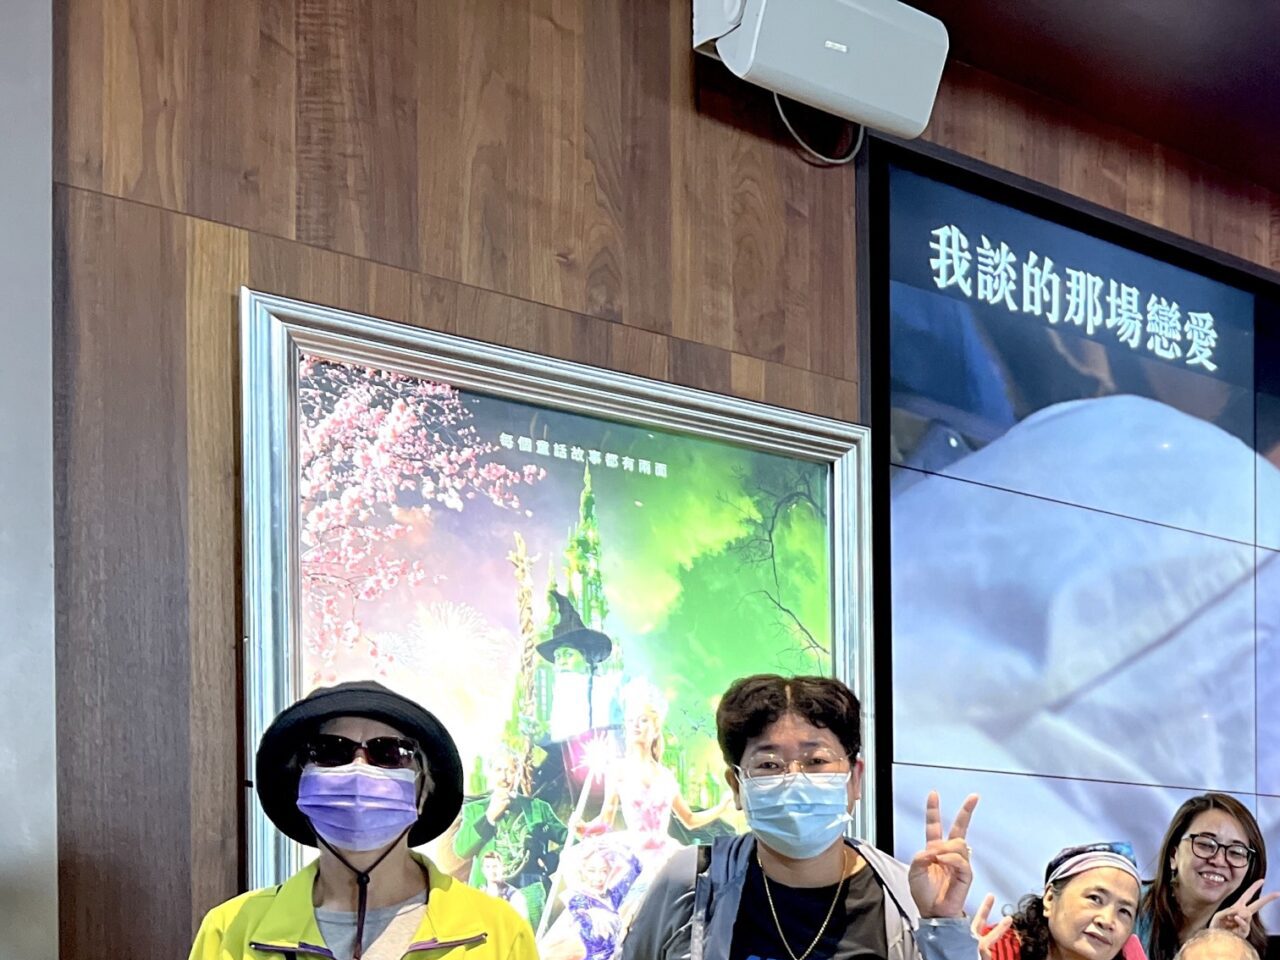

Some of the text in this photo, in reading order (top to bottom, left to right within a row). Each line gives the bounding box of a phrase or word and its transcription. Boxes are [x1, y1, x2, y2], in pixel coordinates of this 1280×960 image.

[928, 224, 1219, 372] 我談的那場戀愛
[499, 432, 668, 478] 每個童話故事都有兩面
